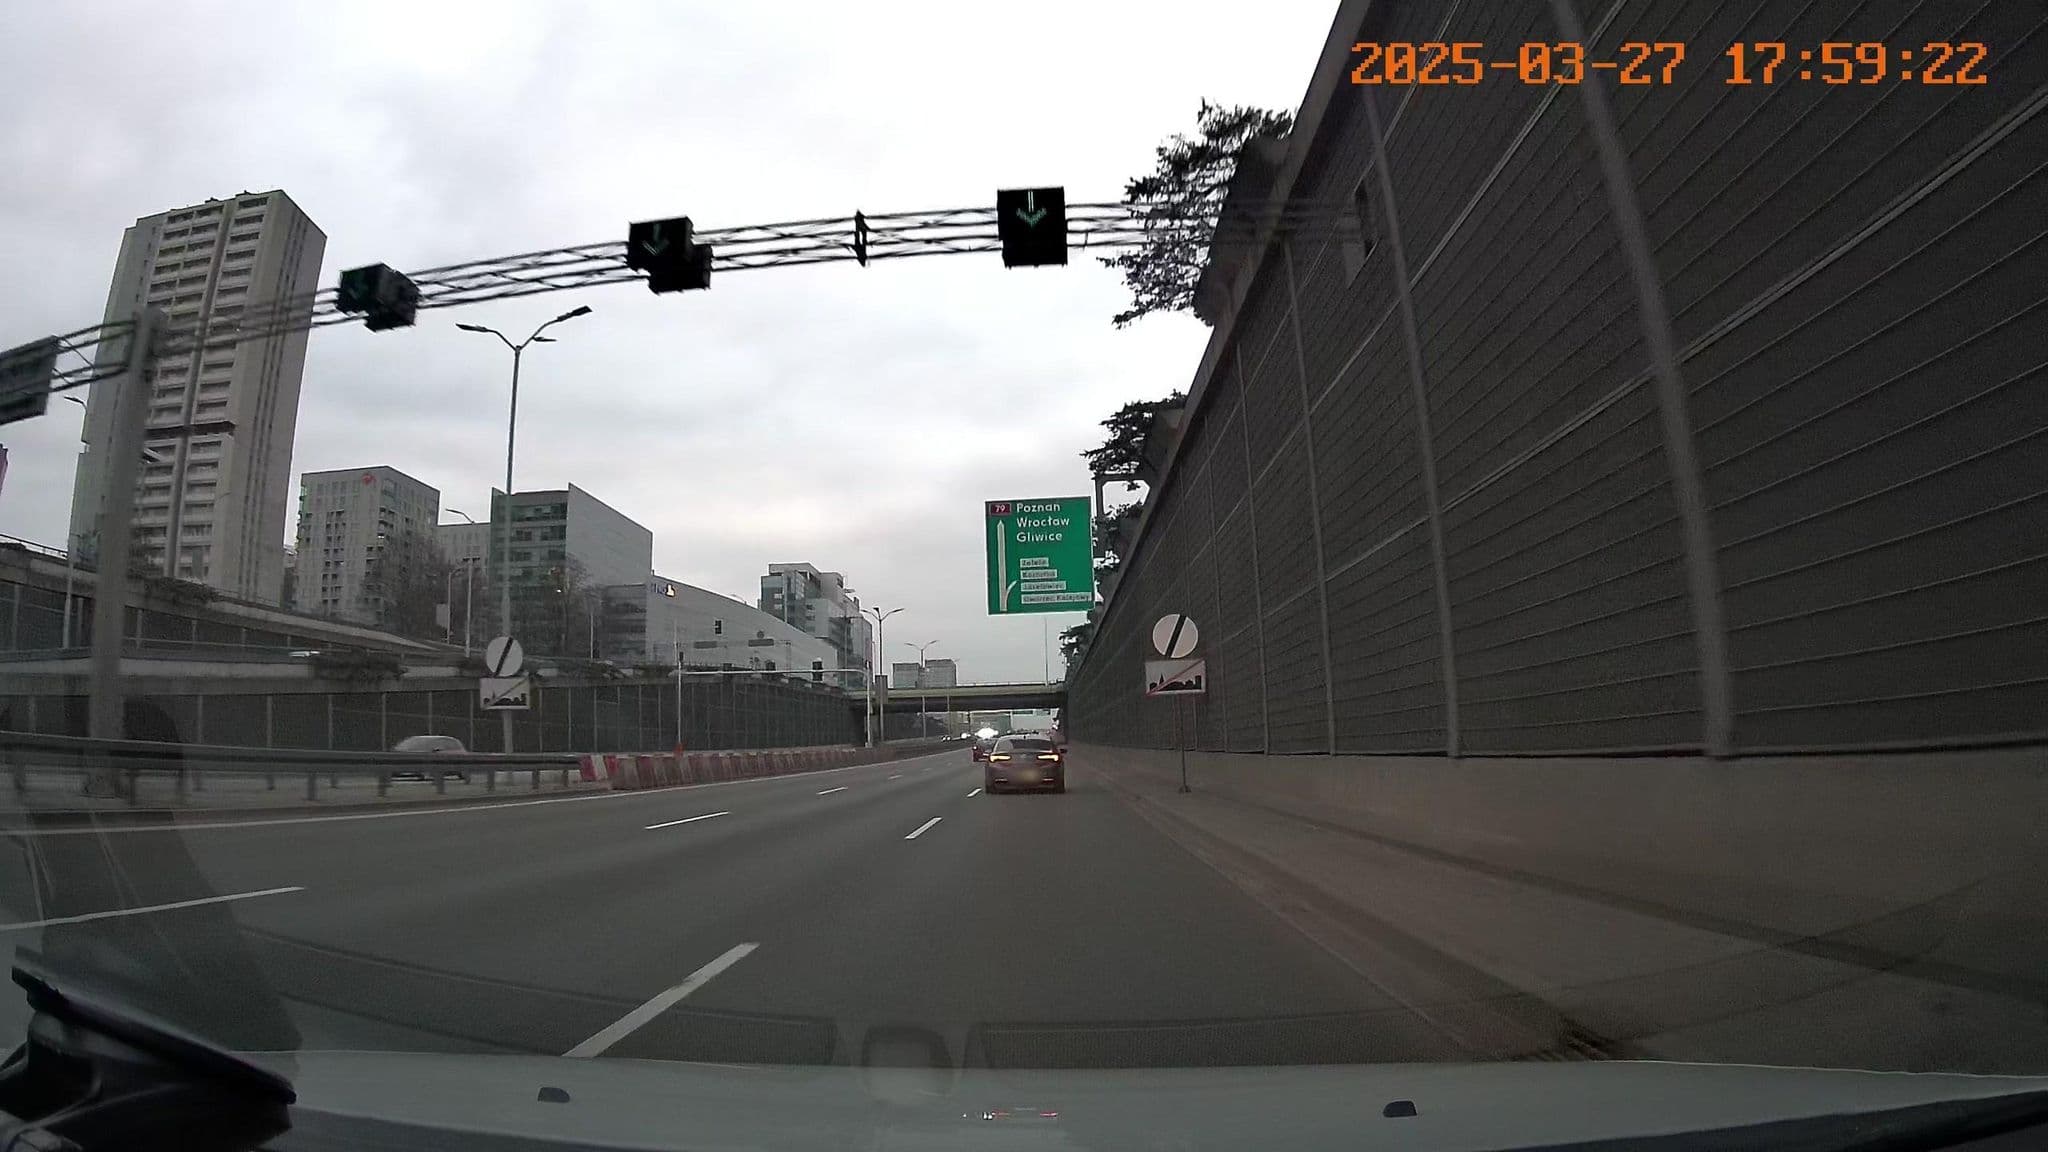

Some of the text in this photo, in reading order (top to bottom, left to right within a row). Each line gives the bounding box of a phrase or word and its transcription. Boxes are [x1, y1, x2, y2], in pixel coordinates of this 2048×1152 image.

[995, 504, 1005, 512] 79
[1016, 515, 1070, 528] Wrocław
[1016, 531, 1063, 543] Gliwice
